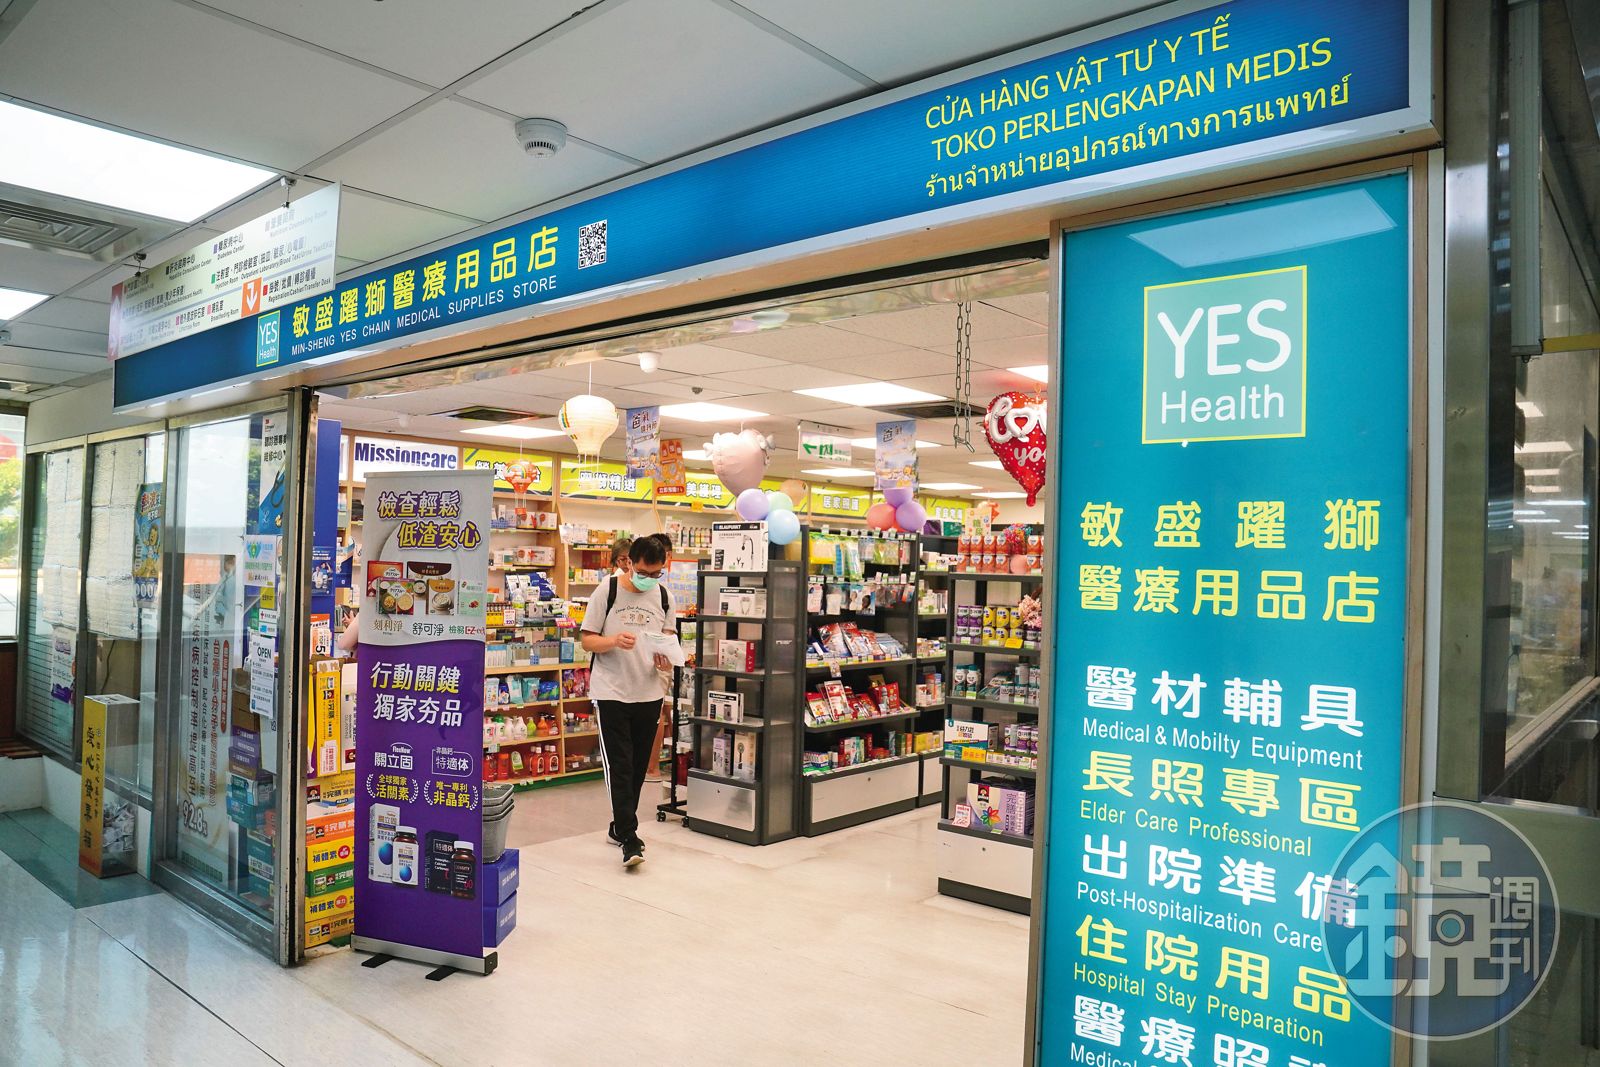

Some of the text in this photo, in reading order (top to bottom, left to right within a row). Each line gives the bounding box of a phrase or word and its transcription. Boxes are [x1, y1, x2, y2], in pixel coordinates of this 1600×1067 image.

[925, 13, 1231, 129] CỬA HÀNG VẬT TƯ Y TẾ
[931, 37, 1333, 162] TOKO PERLENGKAPAN MEDIS
[925, 73, 1353, 198] ร้านจำหน่ายอุปกรณ์ทางการแพทย์
[292, 226, 559, 339] 敏盛躍獅醫療用品店
[291, 275, 557, 356] MIN-SHENG YES CHAIN MEDICAL SUPPLIES STORE
[258, 321, 278, 346] YES
[1157, 299, 1292, 379] YES
[258, 348, 277, 361] Health
[1161, 384, 1285, 424] Health
[354, 442, 457, 469] Missioncare
[1014, 447, 1047, 467] yo
[377, 489, 462, 519] 檢查輕鬆
[397, 520, 482, 549] 低渣安心
[1080, 498, 1381, 552] 敏盛躍獅
[1078, 564, 1380, 623] 醫療用品店
[373, 619, 403, 632] 刻利淨
[412, 622, 445, 636] 舒可淨
[257, 646, 272, 660] OPEN
[370, 661, 461, 694] 行動關鍵
[373, 693, 463, 727] 獨家夯品
[1085, 664, 1364, 738] 醫材輔具
[374, 751, 413, 770] 關立固
[1083, 717, 1363, 771] Medical & Mobilty Equipment
[378, 774, 407, 786] 全球獨家
[435, 756, 469, 772] 特適体
[375, 783, 410, 801] 活關素
[433, 790, 470, 809] 非晶鈣
[436, 781, 468, 793] 唯一專利
[1082, 750, 1362, 832] 長照專區
[1080, 800, 1313, 857] Elder Care Professional
[312, 851, 338, 864] 補體素
[1082, 833, 1359, 929] 出院準備
[309, 902, 335, 914] 補體素
[1077, 880, 1323, 953] Post-Hospitalization Care
[1075, 914, 1351, 1023] 住院用品
[1074, 962, 1324, 1047] Hospital Stay Preparation
